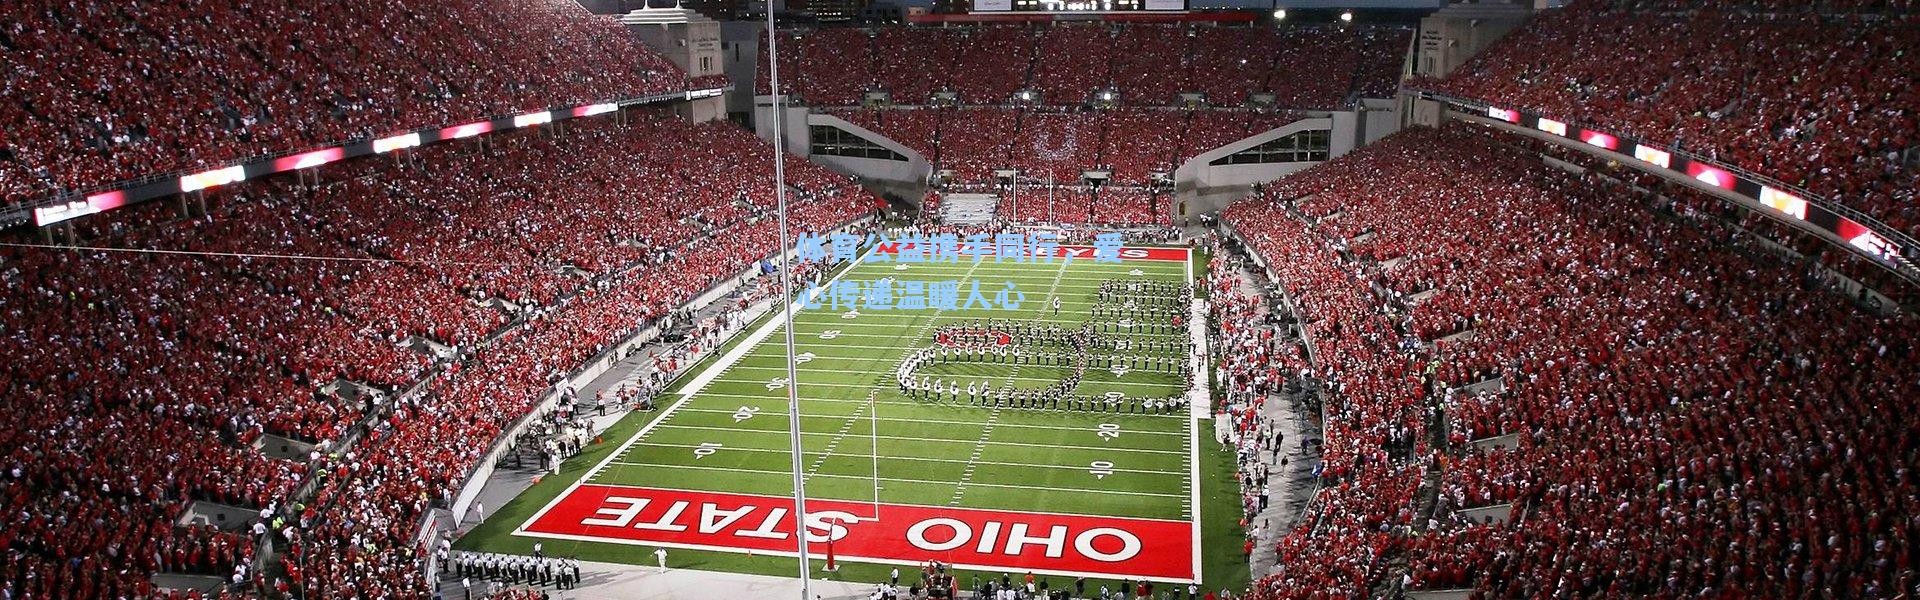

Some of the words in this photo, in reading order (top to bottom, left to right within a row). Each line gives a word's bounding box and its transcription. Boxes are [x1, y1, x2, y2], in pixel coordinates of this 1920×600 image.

[1097, 423, 1120, 438] 20
[693, 442, 723, 456] 10
[1088, 461, 1114, 475] 10
[582, 496, 858, 544] STATE
[906, 517, 1143, 563] OHIO
